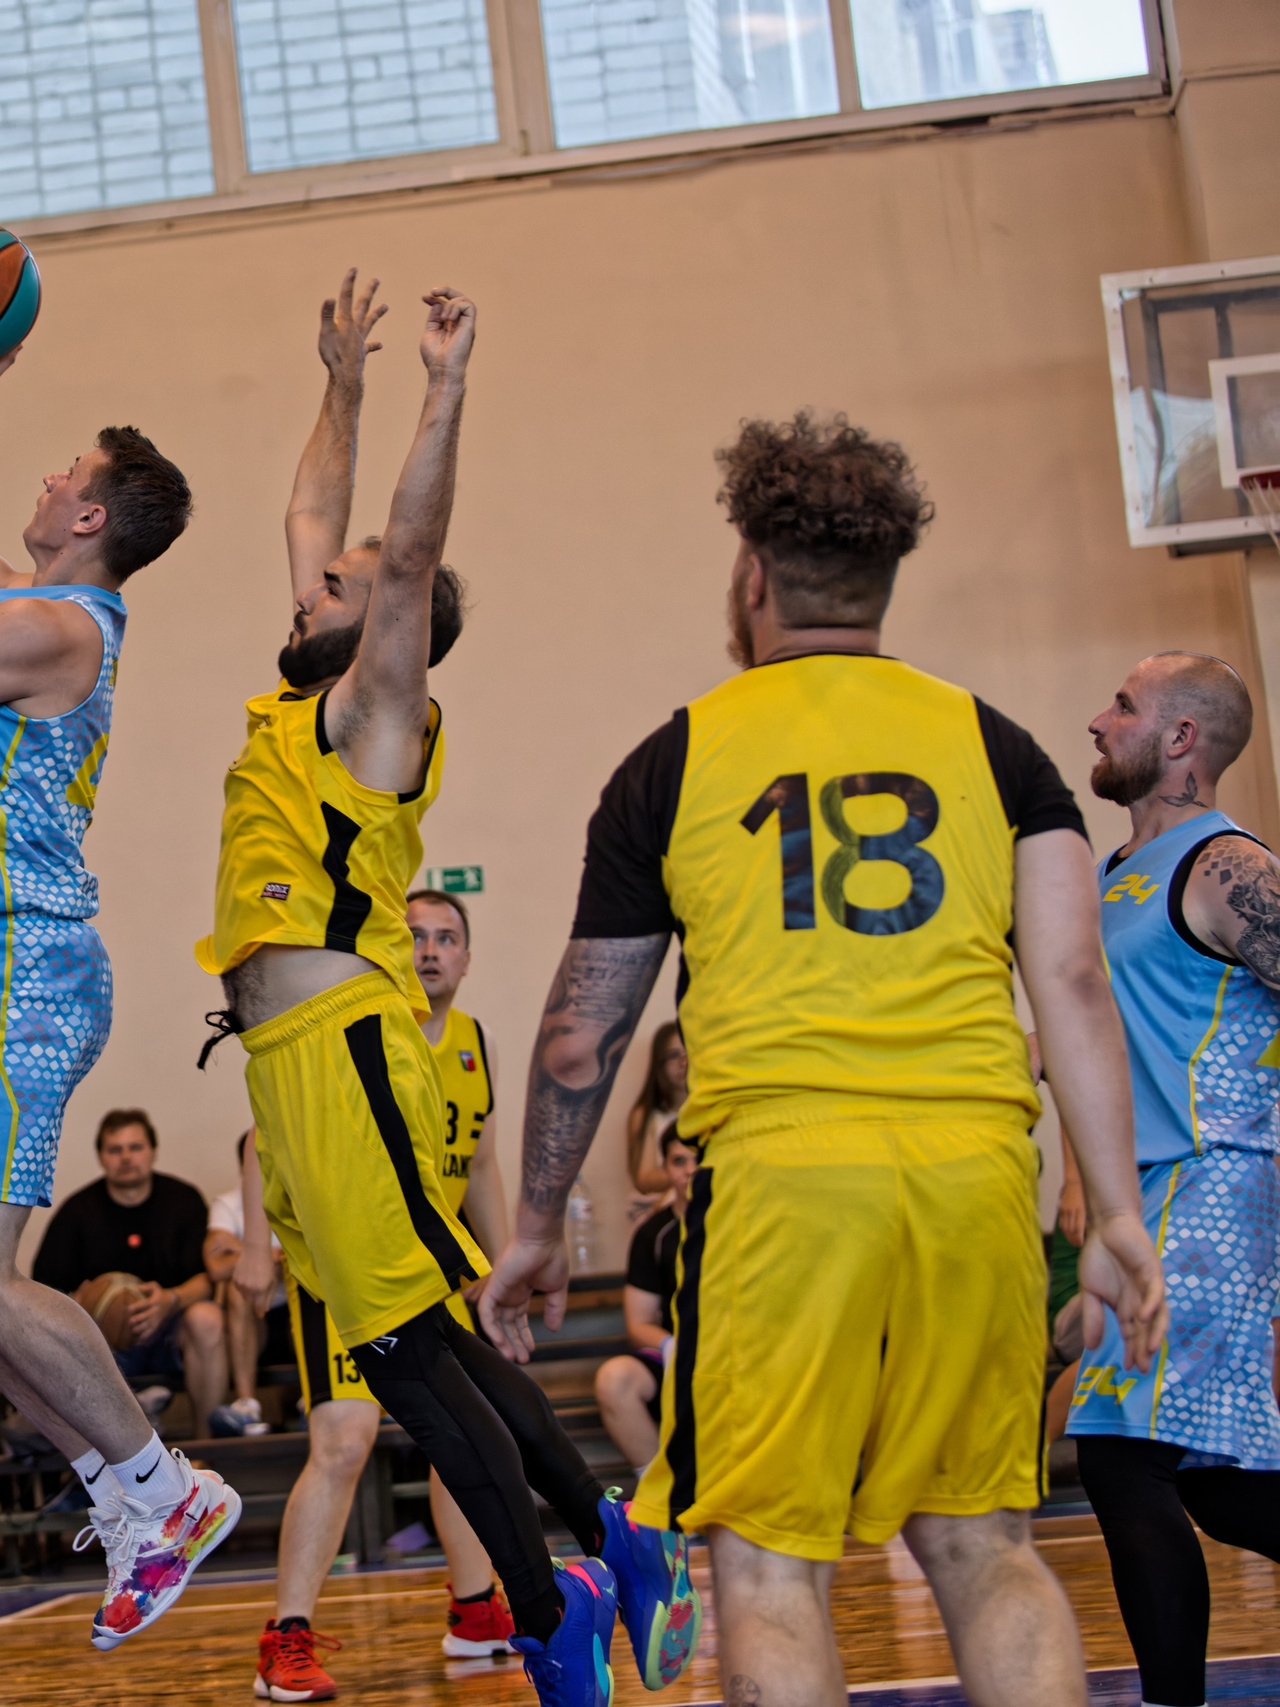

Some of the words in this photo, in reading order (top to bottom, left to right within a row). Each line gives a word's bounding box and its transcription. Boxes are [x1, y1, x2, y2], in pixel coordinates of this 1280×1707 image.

[739, 771, 945, 936] 18
[1102, 873, 1160, 905] 24
[333, 1353, 361, 1384] 13
[1071, 1366, 1138, 1405] 24
